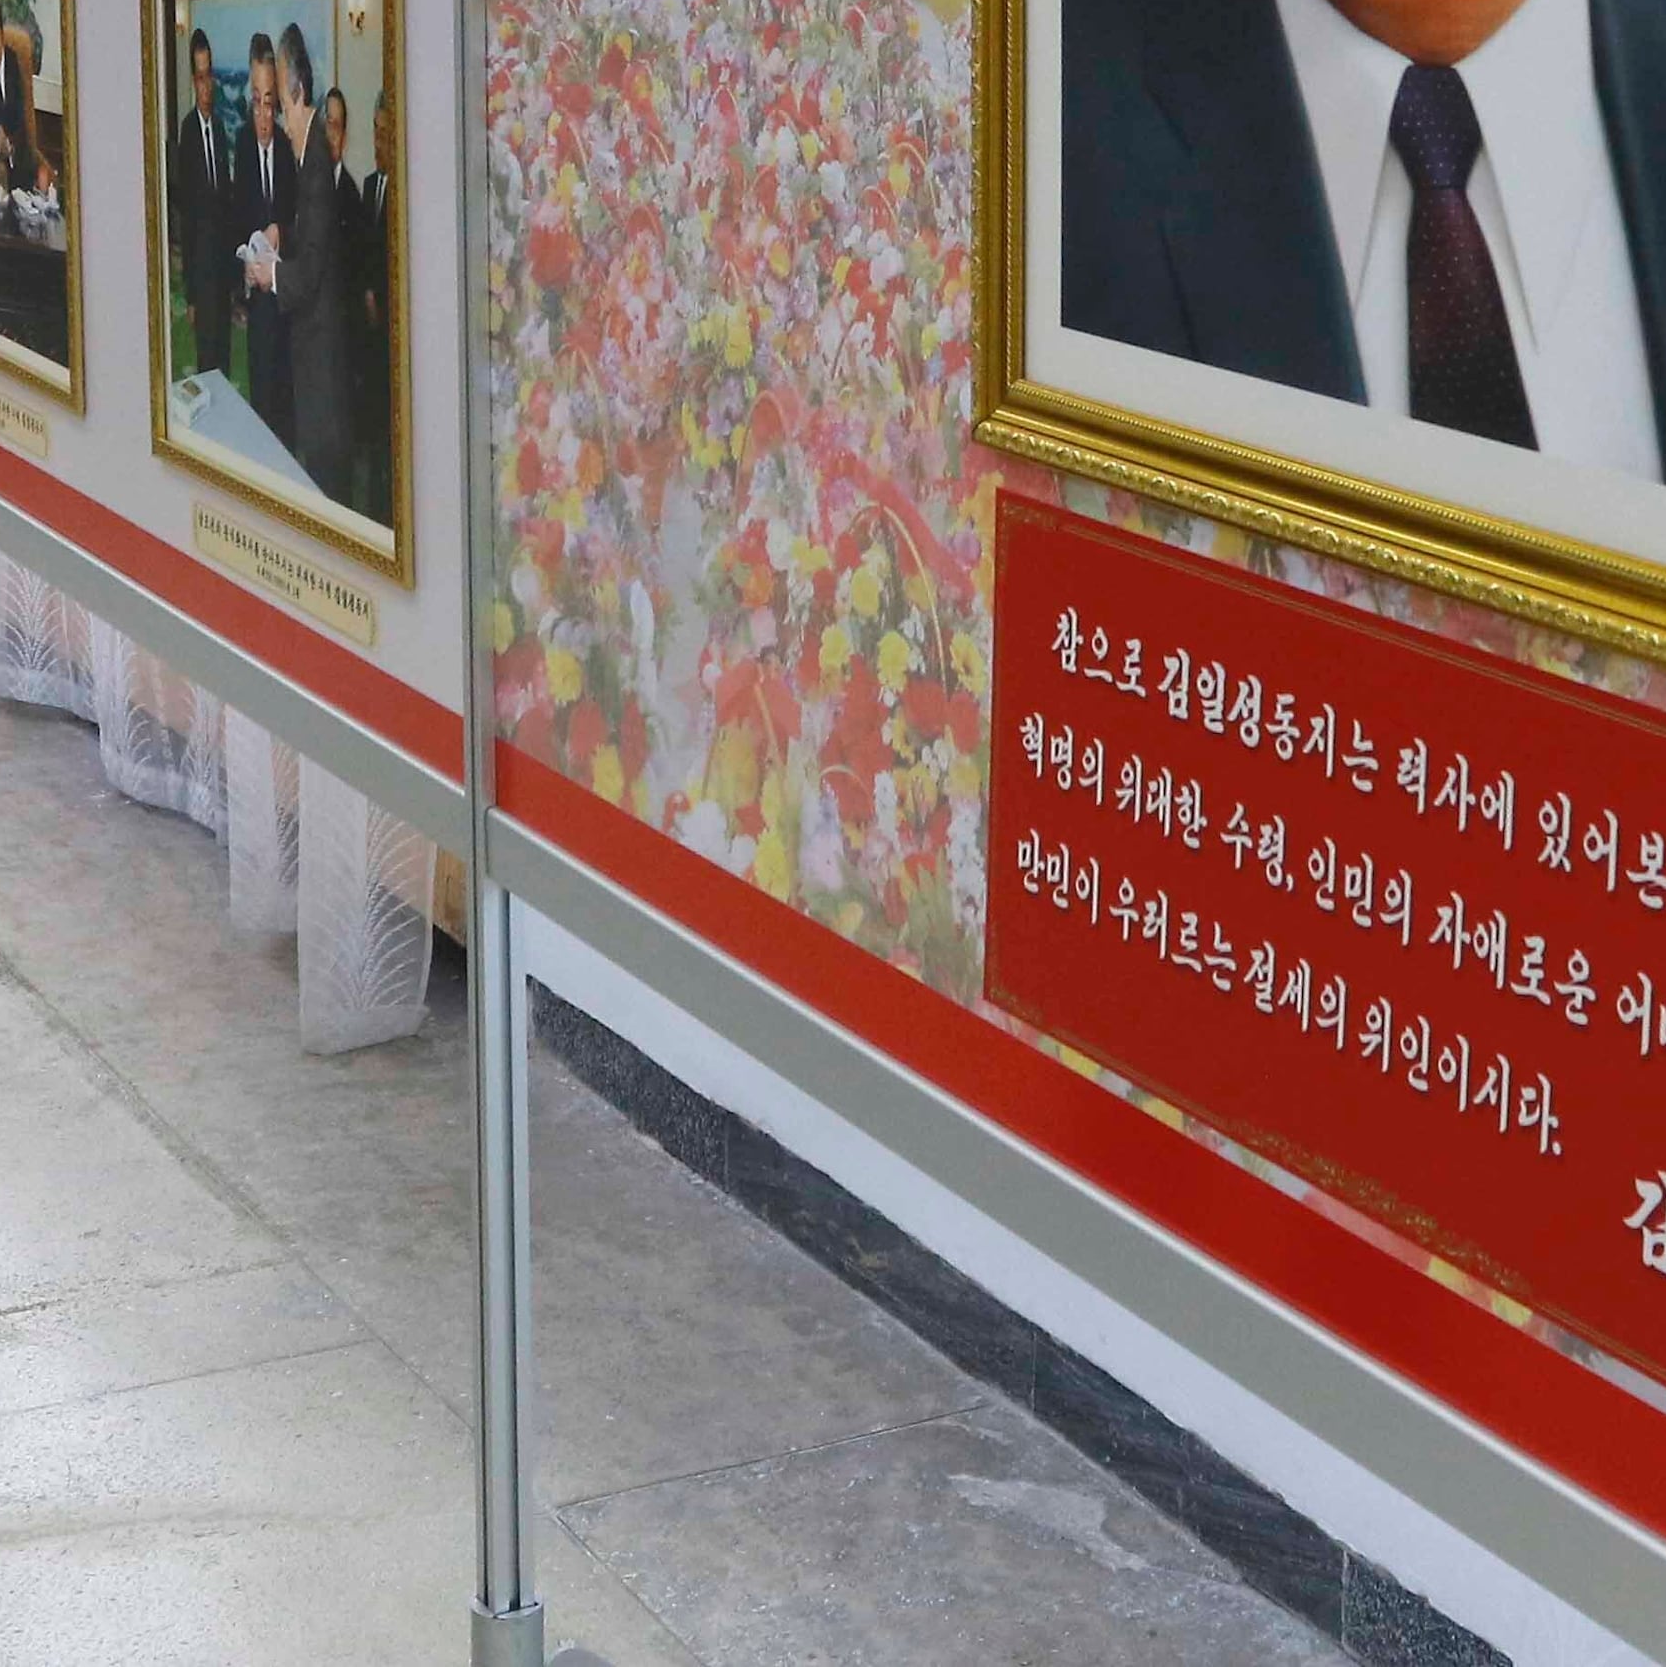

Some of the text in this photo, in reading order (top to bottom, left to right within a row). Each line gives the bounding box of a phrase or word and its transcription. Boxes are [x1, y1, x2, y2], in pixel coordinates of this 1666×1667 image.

[1019, 712, 1104, 805] 혁명의
[1115, 754, 1208, 849] 위대한
[1220, 803, 1294, 891] 수령,
[1308, 837, 1412, 945] 인민의
[1429, 892, 1596, 1025] 자애로운
[1051, 607, 1146, 697] 참으로
[1157, 648, 1379, 792] 김일성동지는
[1397, 738, 1514, 850] 력사에
[1018, 829, 1561, 1155] 만민이 우러르는 절세의 위인이시다.
